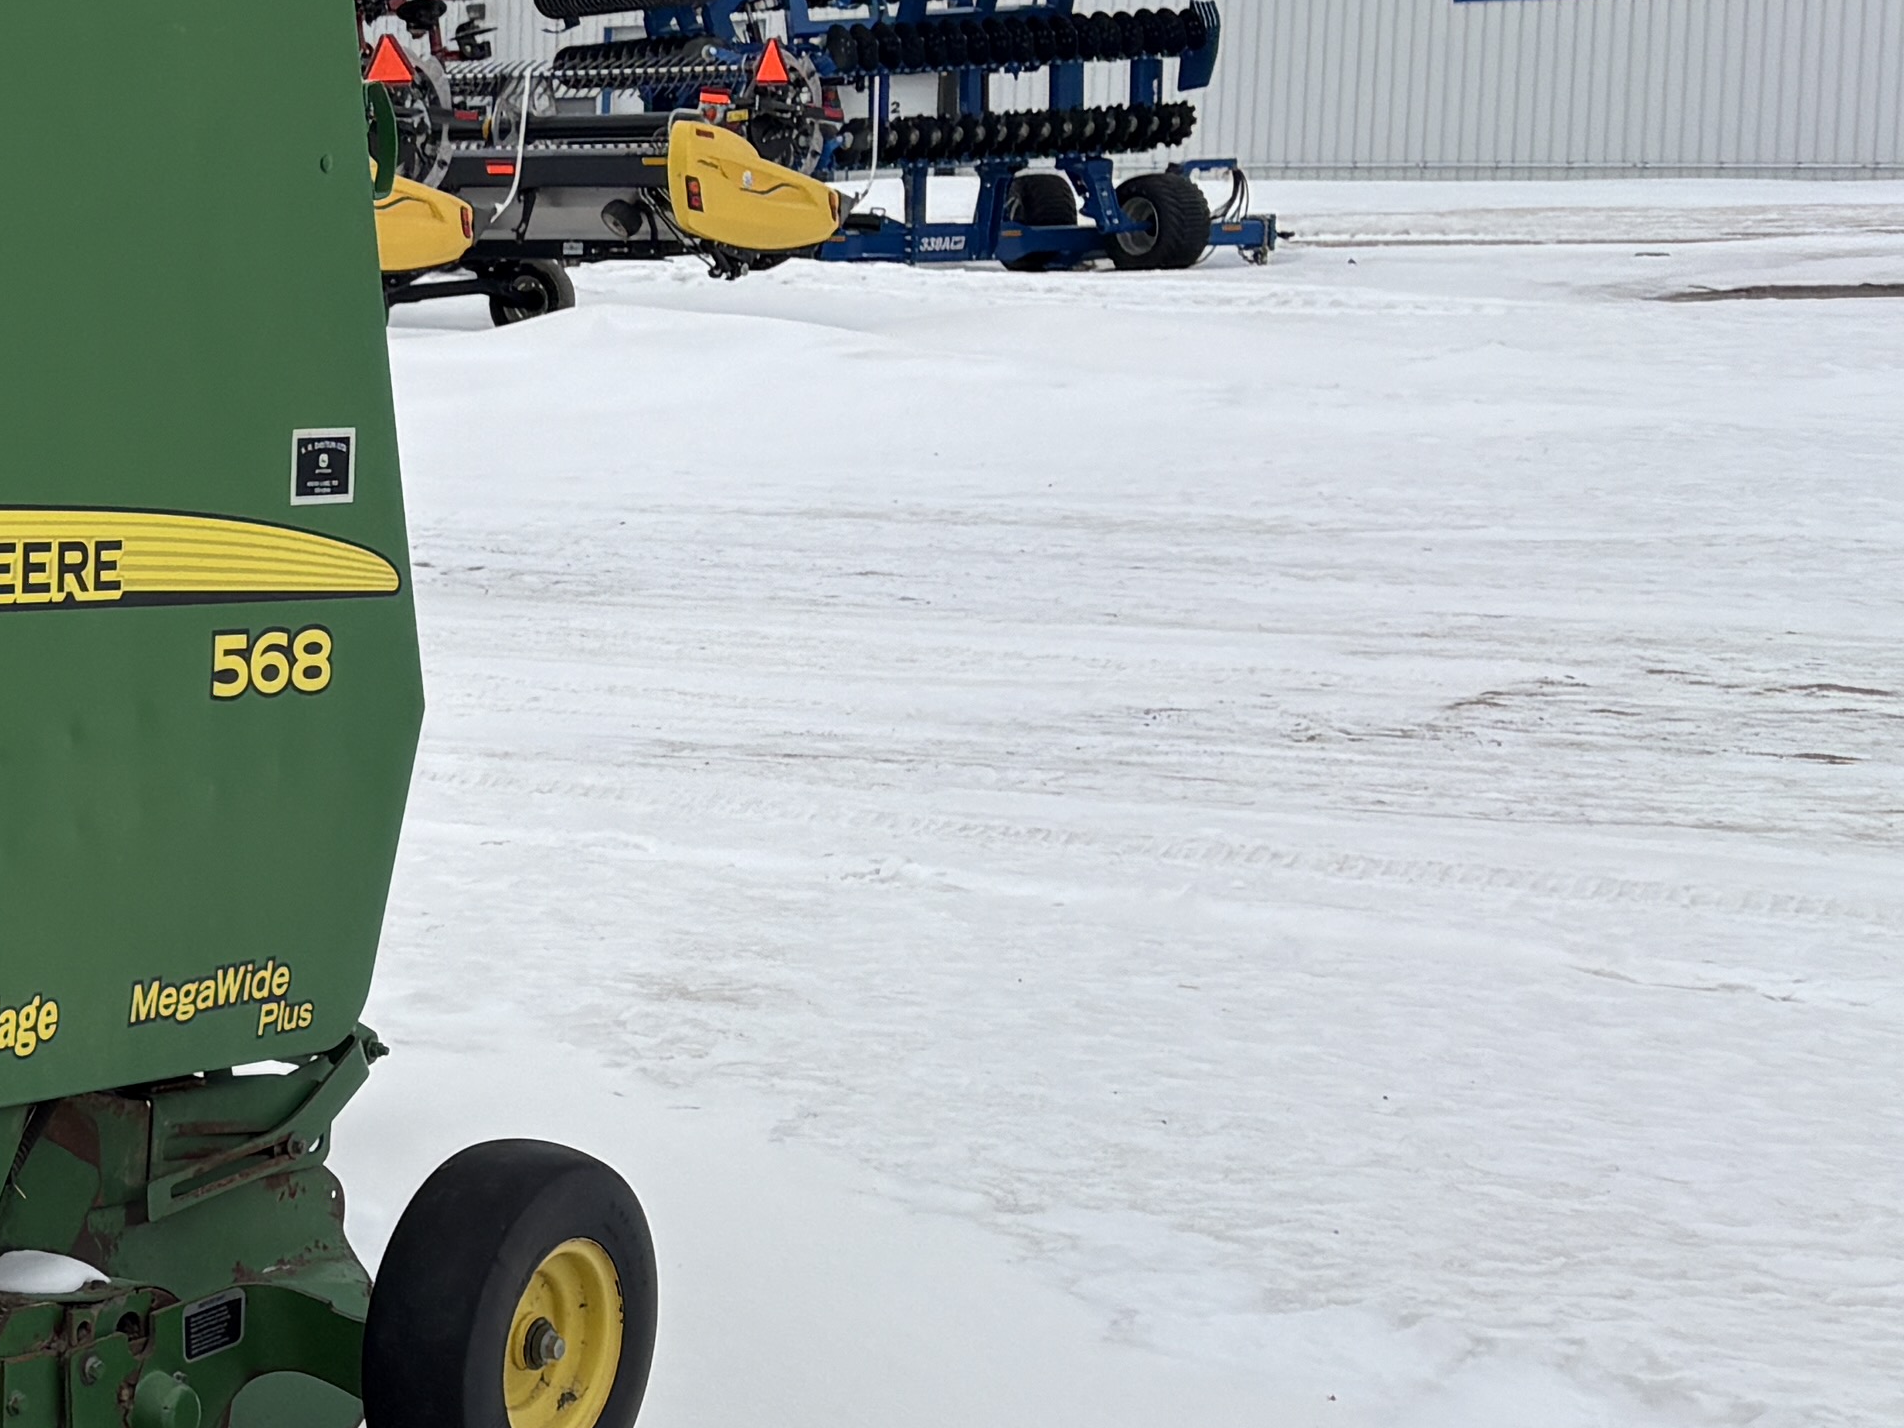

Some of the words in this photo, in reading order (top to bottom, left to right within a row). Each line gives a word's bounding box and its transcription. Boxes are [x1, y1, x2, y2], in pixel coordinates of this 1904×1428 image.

[212, 628, 332, 698] 568
[129, 959, 290, 1022] MegaWide
[257, 1000, 314, 1037] Plus
